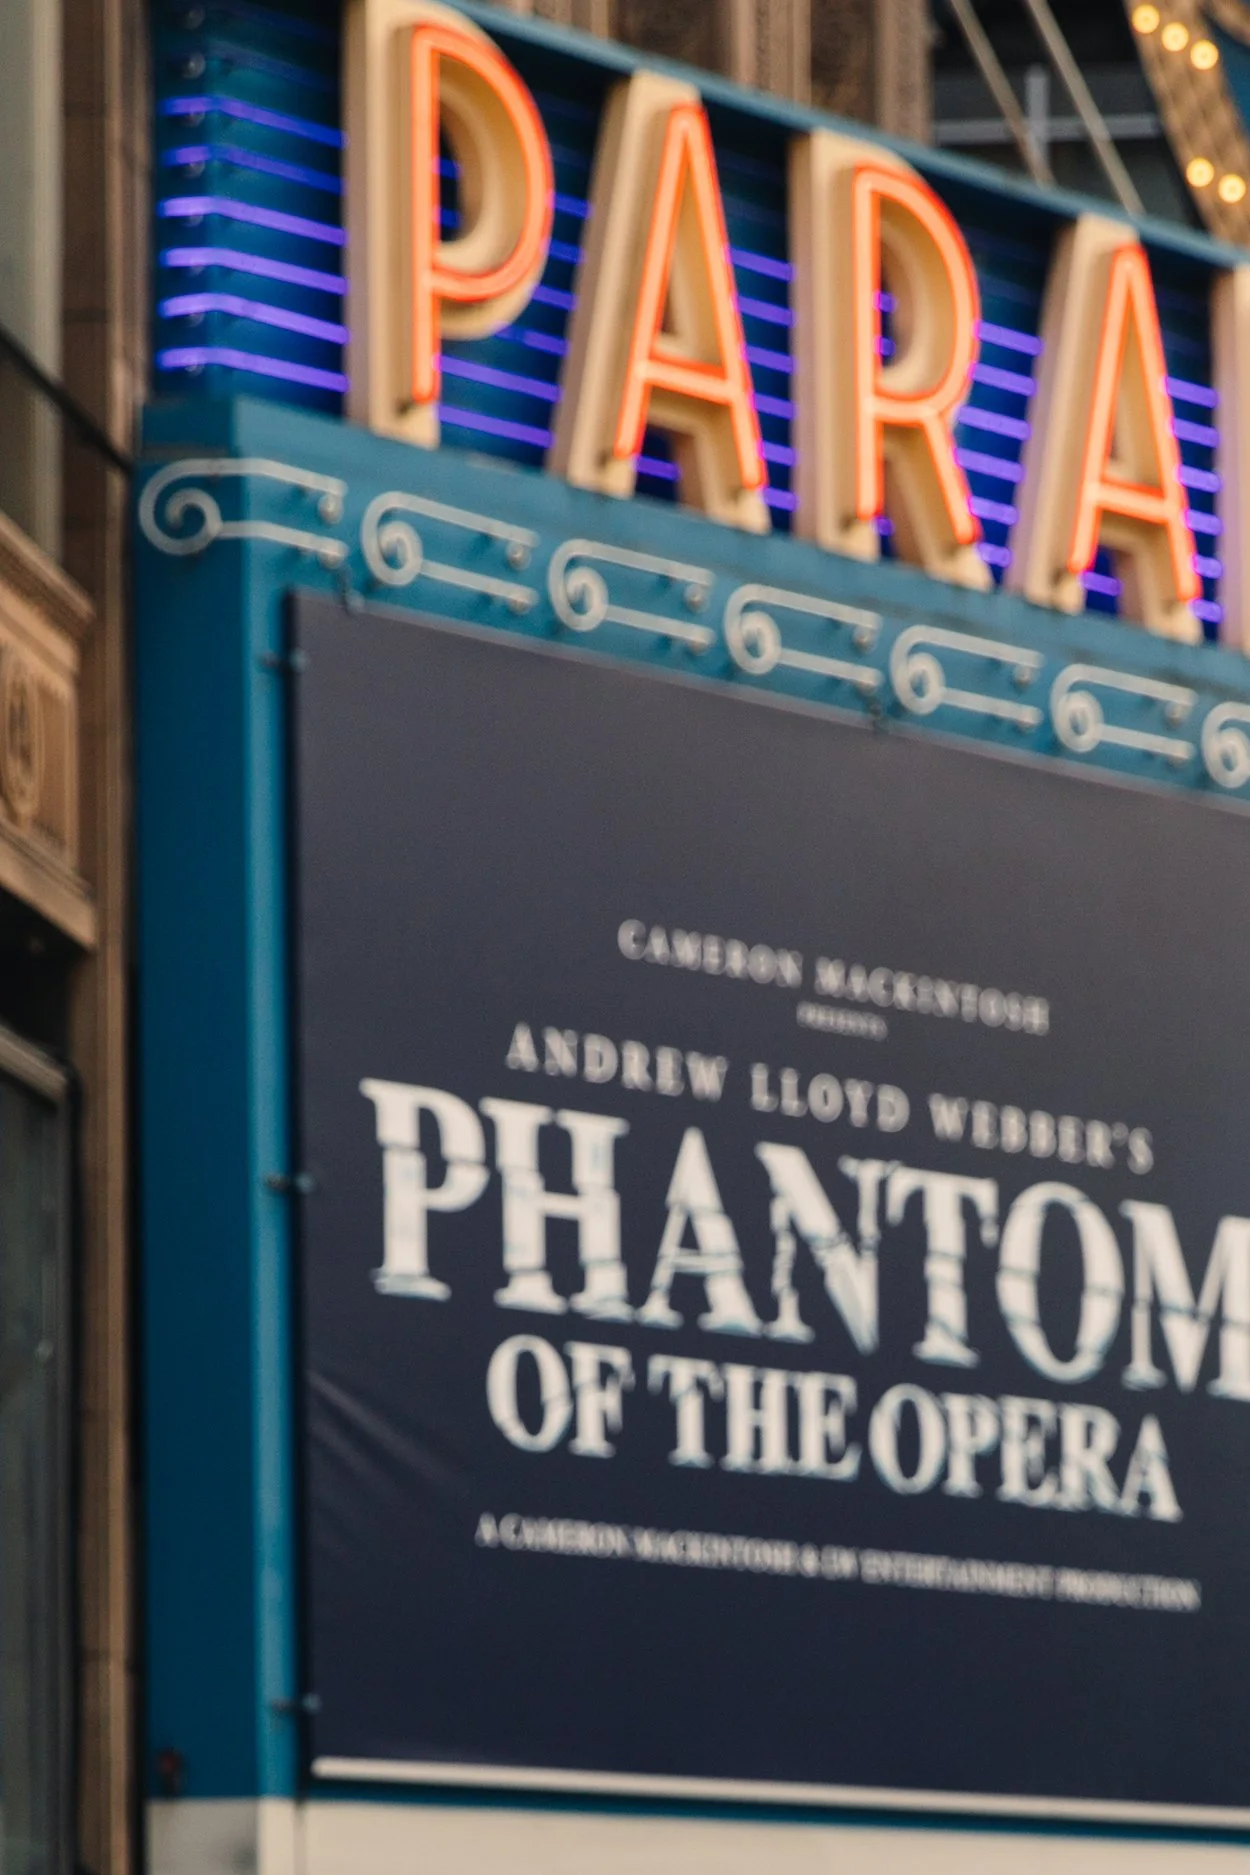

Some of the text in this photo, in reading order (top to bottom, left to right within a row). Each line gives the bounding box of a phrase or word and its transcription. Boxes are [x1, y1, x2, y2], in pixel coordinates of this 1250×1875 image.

[618, 920, 1050, 1037] CAMERON MACKINTOSH
[507, 1022, 1154, 1175] ANDREW LLOYD WEBBER'S
[487, 1335, 1183, 1522] OF THE OPERA
